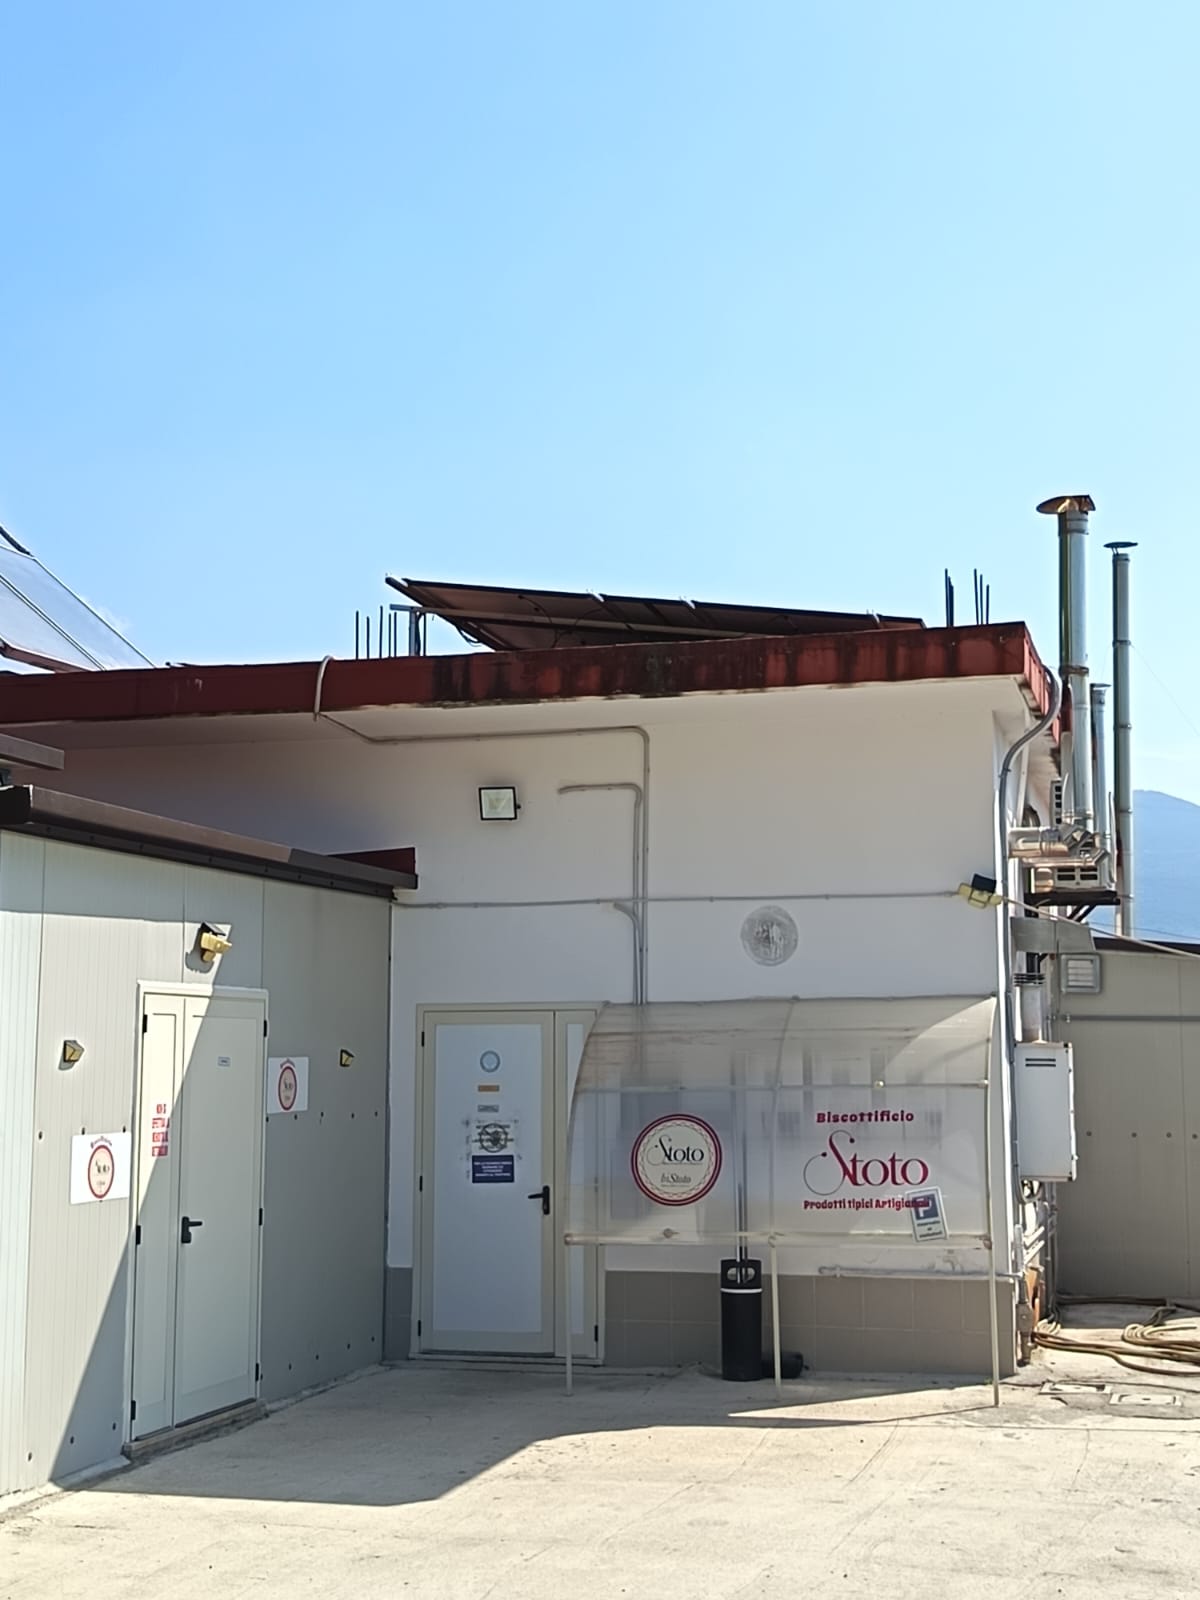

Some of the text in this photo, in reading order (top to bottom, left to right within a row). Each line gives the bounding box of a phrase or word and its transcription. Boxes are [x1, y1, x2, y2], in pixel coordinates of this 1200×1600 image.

[816, 1109, 914, 1123] Biscottificio
[646, 1134, 704, 1166] Stoto
[803, 1129, 929, 1196] Stoto
[803, 1199, 846, 1210] Prodotti
[847, 1198, 873, 1210] tipici
